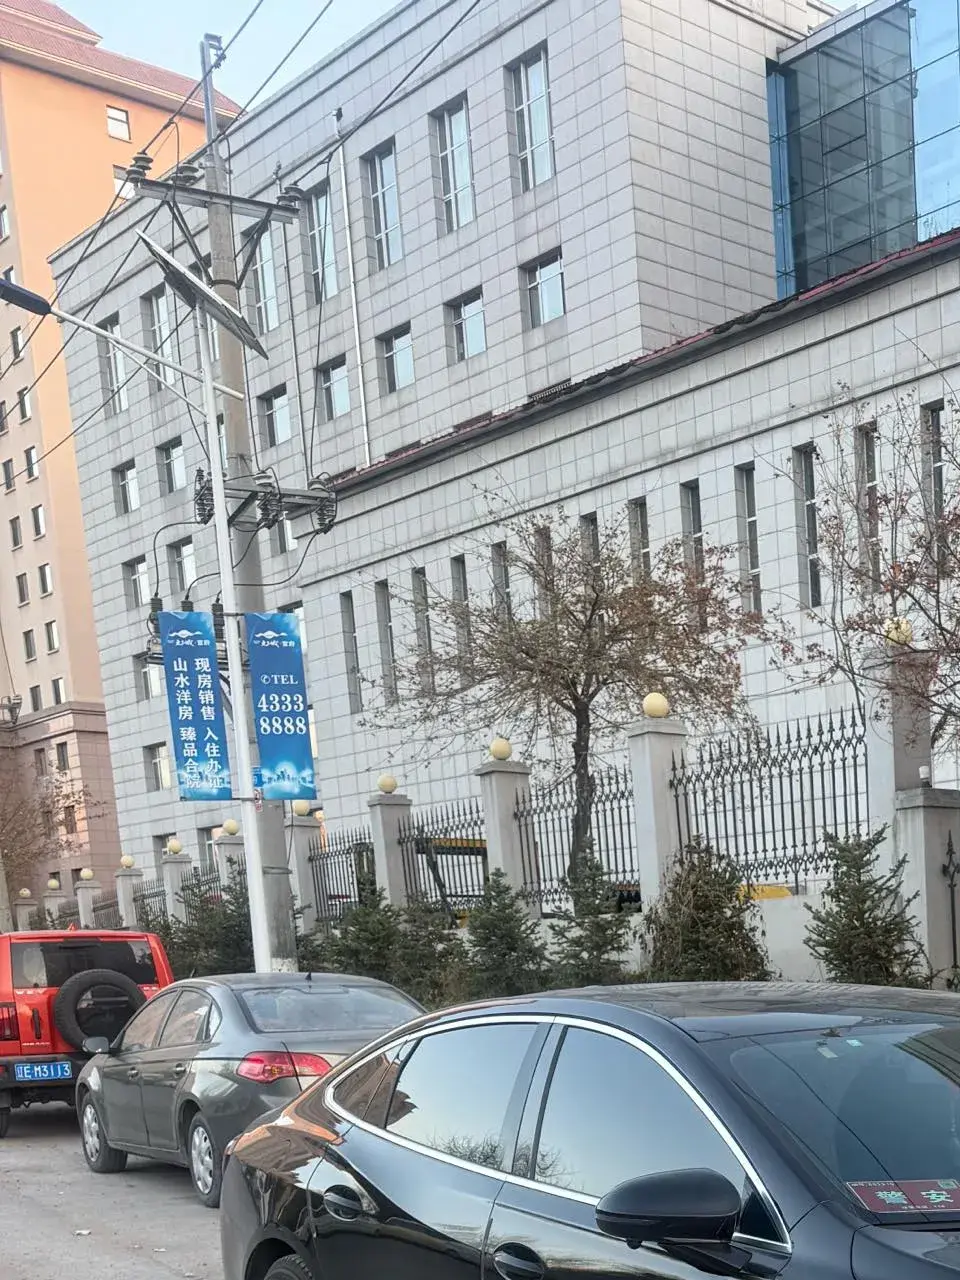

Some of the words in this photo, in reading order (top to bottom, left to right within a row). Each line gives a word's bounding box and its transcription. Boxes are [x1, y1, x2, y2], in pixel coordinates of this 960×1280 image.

[173, 657, 194, 721] 山水洋房
[194, 657, 216, 721] 现房销售
[257, 693, 304, 713] 4333
[271, 674, 299, 685] TEL
[259, 716, 307, 735] 8888
[179, 726, 201, 789] 臻品合院
[203, 726, 224, 789] 入住办证
